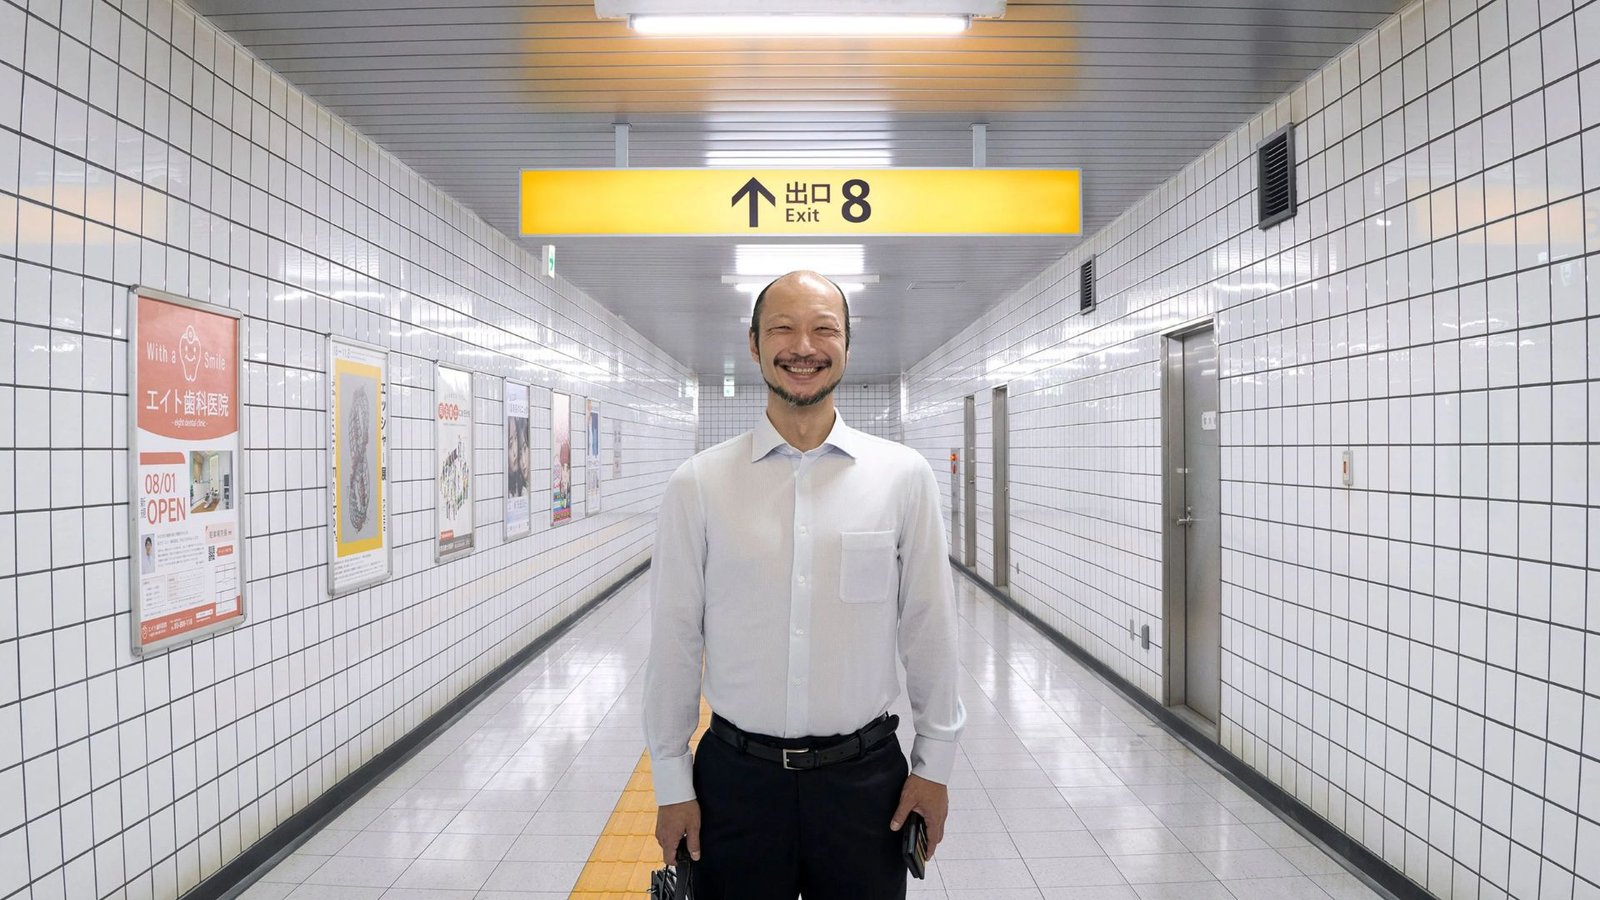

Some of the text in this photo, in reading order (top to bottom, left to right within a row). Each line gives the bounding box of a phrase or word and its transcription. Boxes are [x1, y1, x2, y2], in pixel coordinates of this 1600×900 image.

[786, 181, 831, 205] 出口
[841, 178, 872, 223] 8
[785, 207, 820, 223] Exit
[146, 342, 226, 371] With a Smile
[146, 389, 229, 417] エイト歯科医院
[145, 472, 176, 495] 08/01
[147, 497, 186, 525] OPEN
